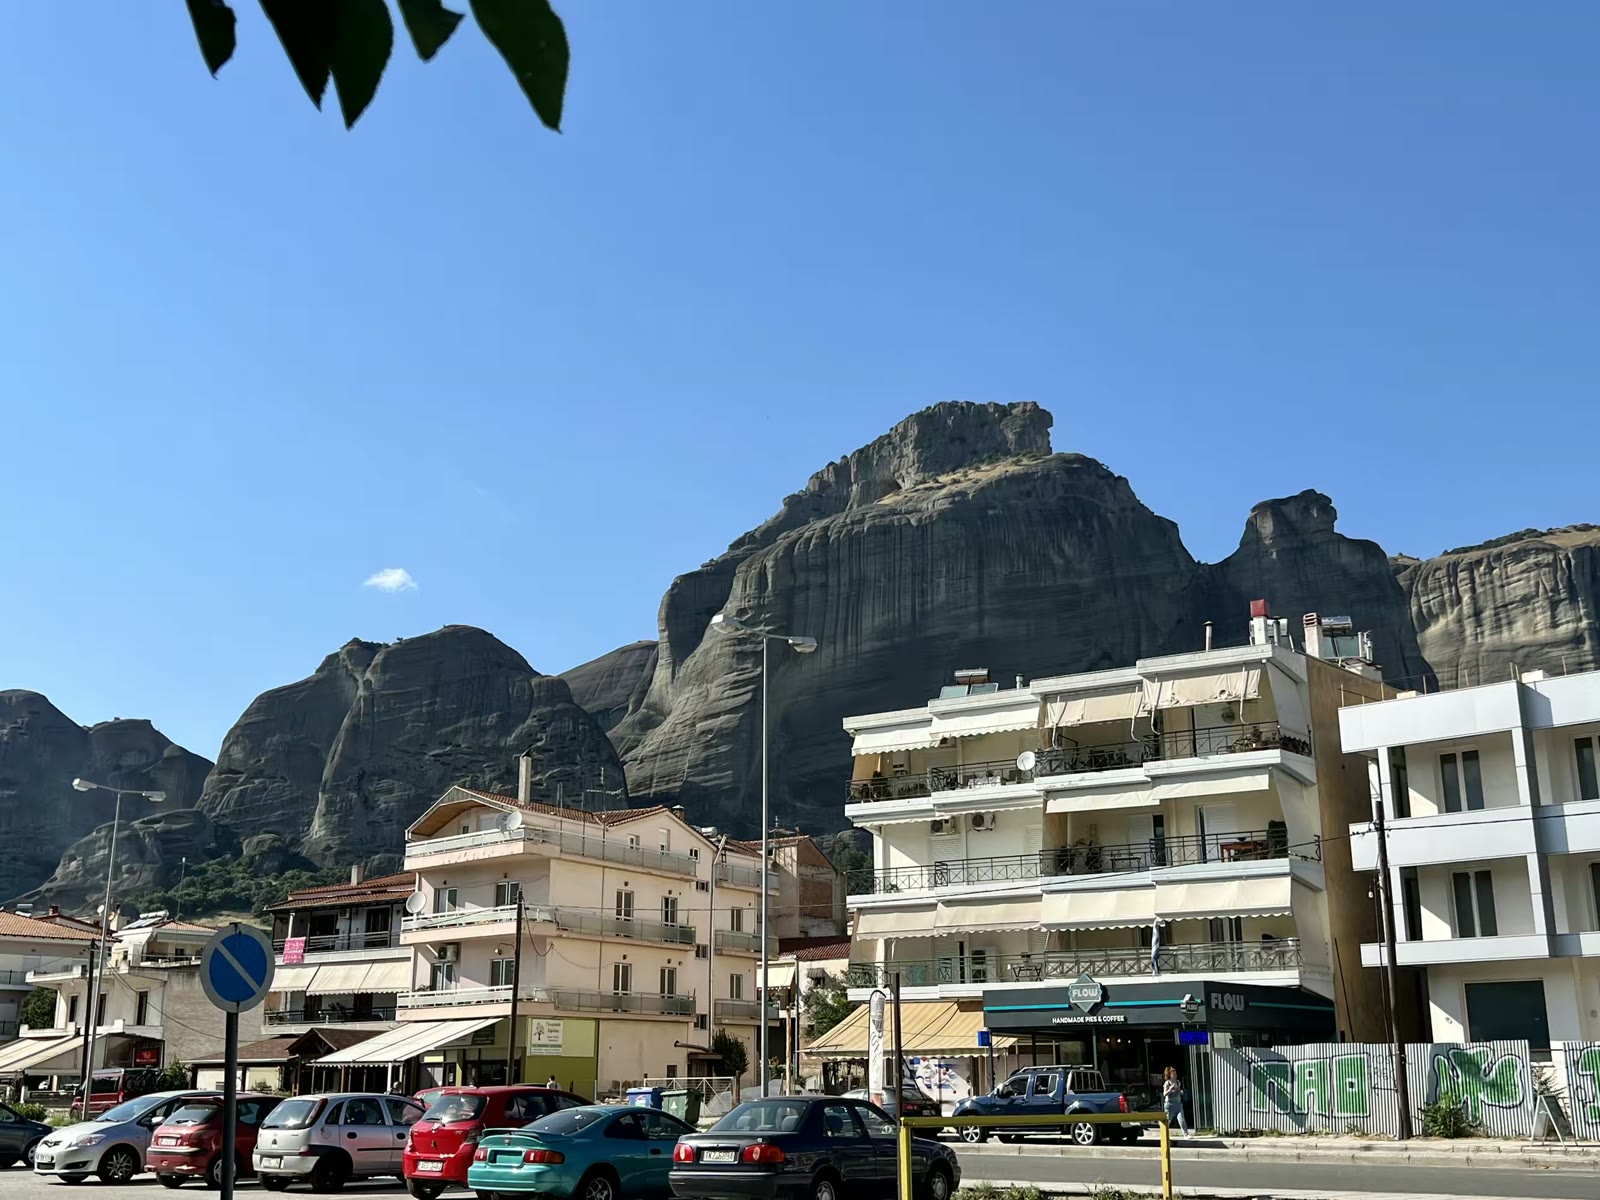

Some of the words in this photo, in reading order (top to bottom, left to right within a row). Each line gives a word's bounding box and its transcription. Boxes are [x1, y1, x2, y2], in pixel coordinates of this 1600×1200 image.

[1072, 988, 1098, 997] FLOW
[1210, 993, 1245, 1011] FLOW
[1052, 1016, 1084, 1024] HANDMADE
